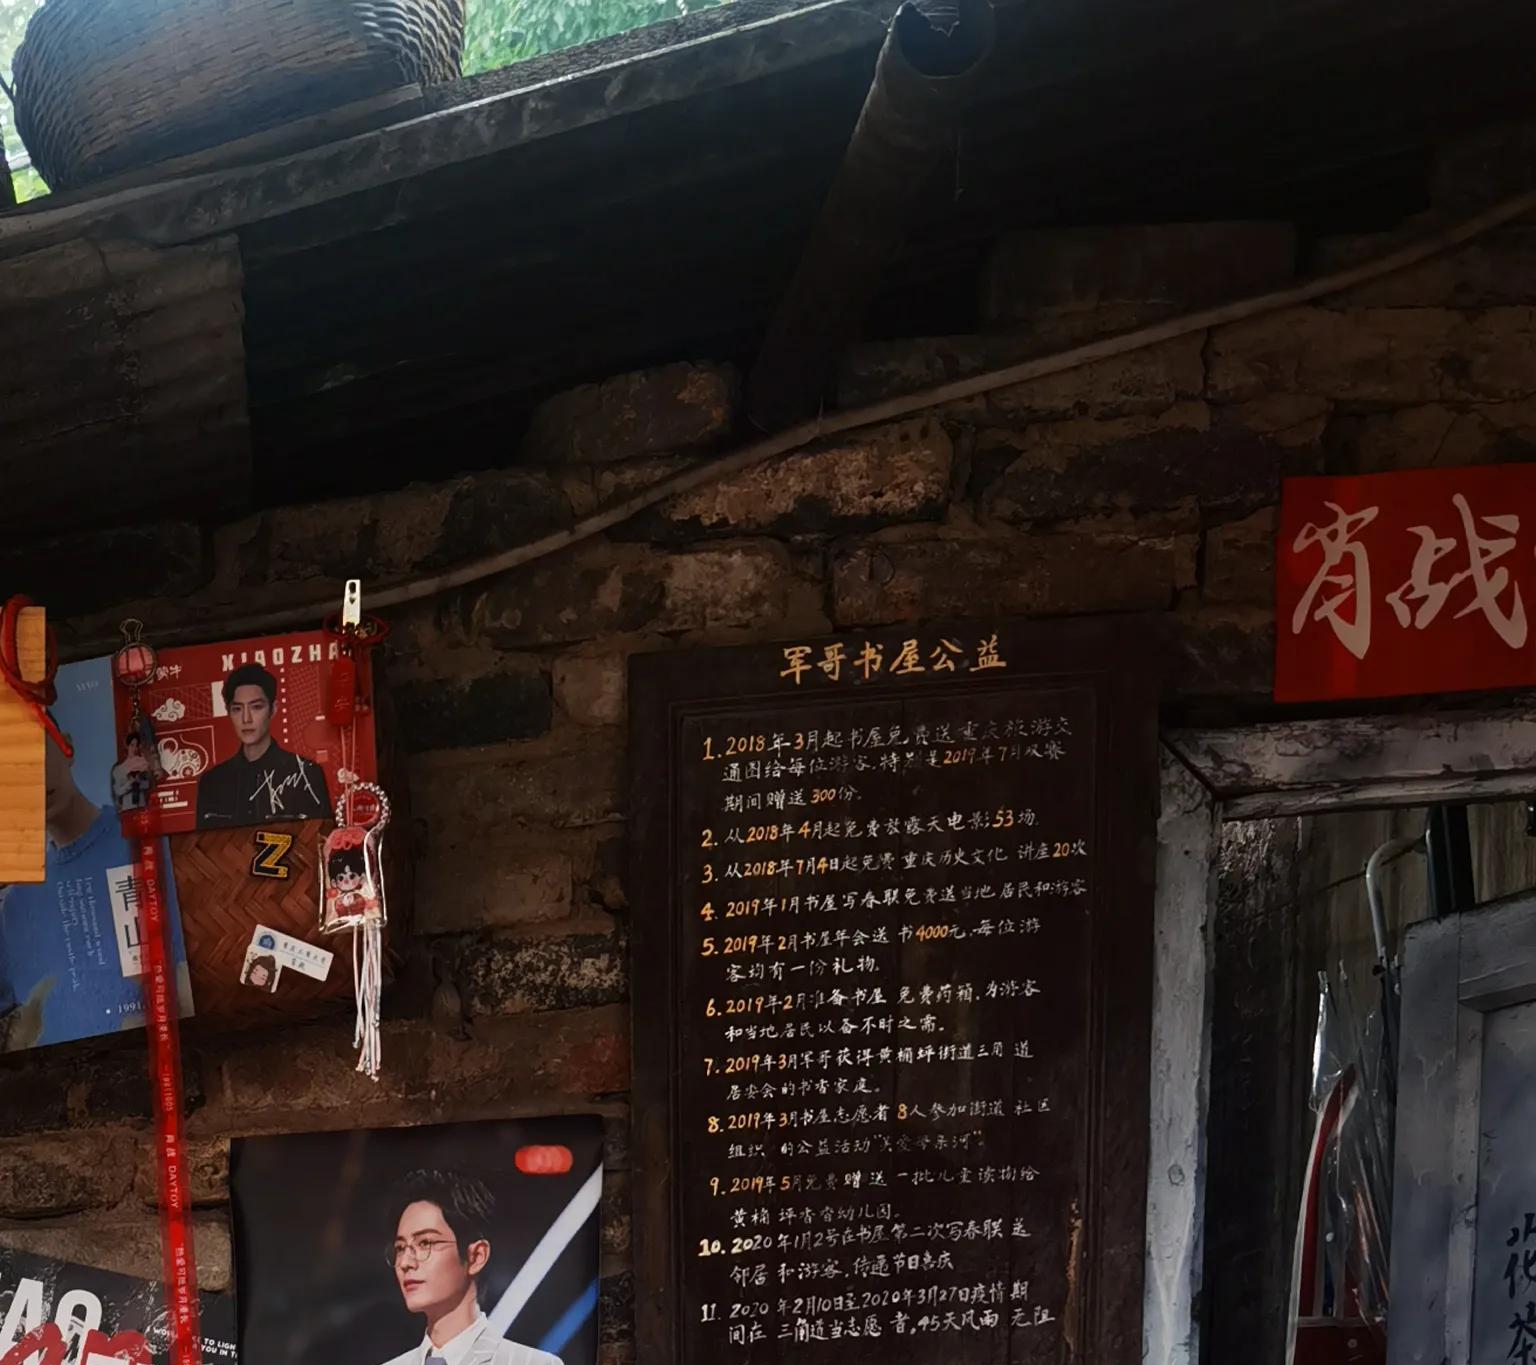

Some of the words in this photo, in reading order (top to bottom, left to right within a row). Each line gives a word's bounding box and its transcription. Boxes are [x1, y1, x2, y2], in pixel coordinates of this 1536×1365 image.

[1292, 493, 1528, 660] 肖战
[779, 633, 1008, 687] 军哥书屋公益
[252, 832, 292, 879] Z
[168, 1165, 179, 1209] DAYTOY
